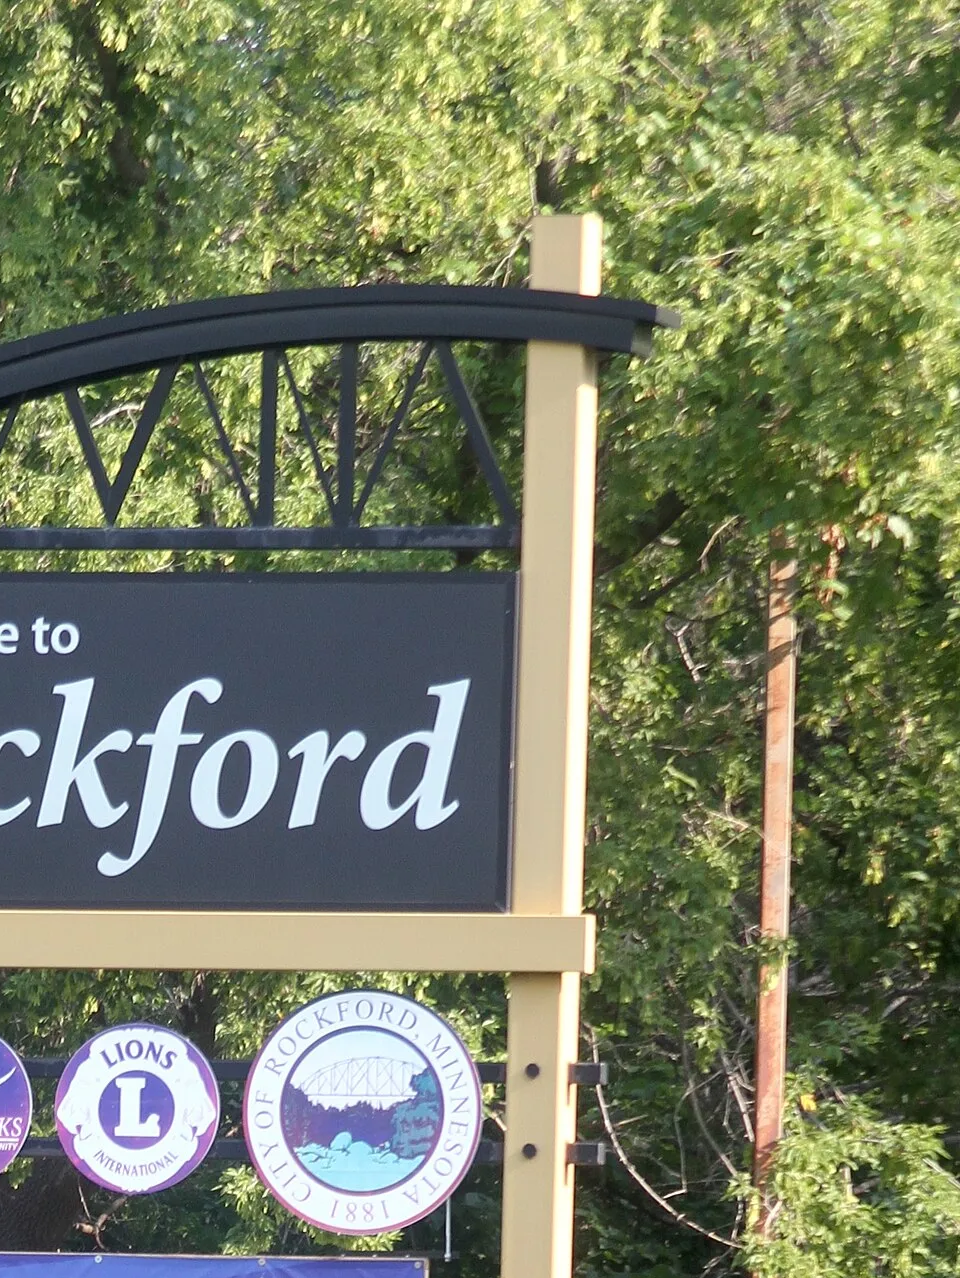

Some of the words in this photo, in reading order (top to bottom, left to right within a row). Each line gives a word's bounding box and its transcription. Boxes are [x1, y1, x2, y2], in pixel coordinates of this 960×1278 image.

[33, 615, 80, 654] to
[100, 1039, 178, 1070] LIONS
[264, 998, 420, 1076] ROCKFORD,
[114, 1077, 160, 1138] L
[255, 1090, 274, 1130] OF
[403, 1033, 471, 1206] MINNESOTA
[93, 1149, 179, 1178] INTERNATIONAL
[259, 1142, 312, 1203] CITY
[330, 1200, 390, 1223] 1881
